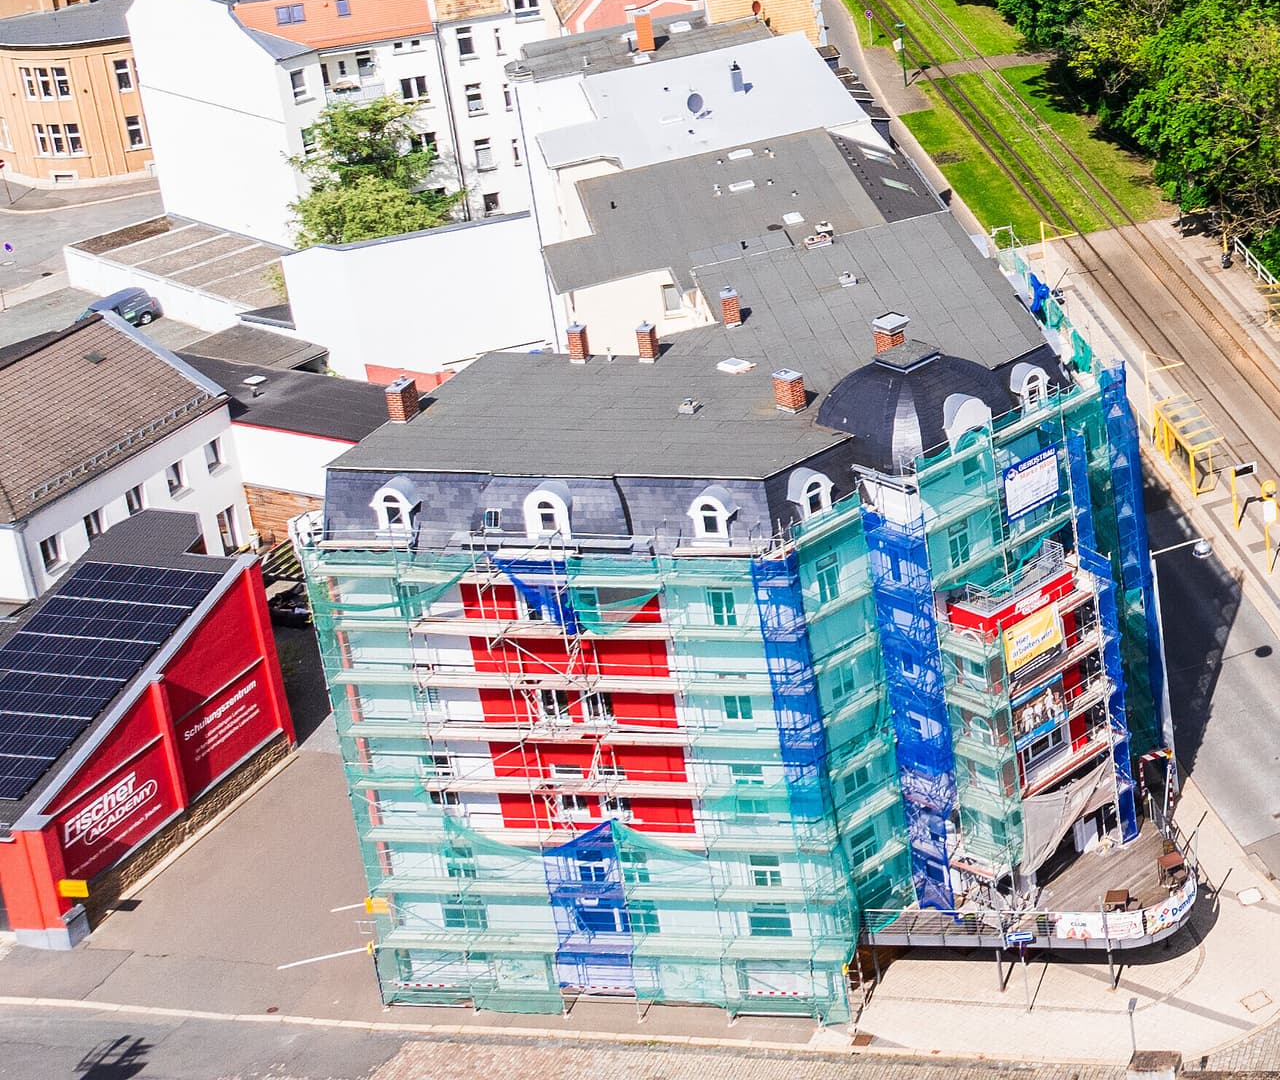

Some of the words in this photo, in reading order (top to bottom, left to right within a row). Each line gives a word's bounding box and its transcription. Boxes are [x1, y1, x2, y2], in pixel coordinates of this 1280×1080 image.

[184, 680, 257, 741] Schulungszentrum
[65, 771, 137, 844] Fischer
[89, 783, 153, 841] ACADEMY
